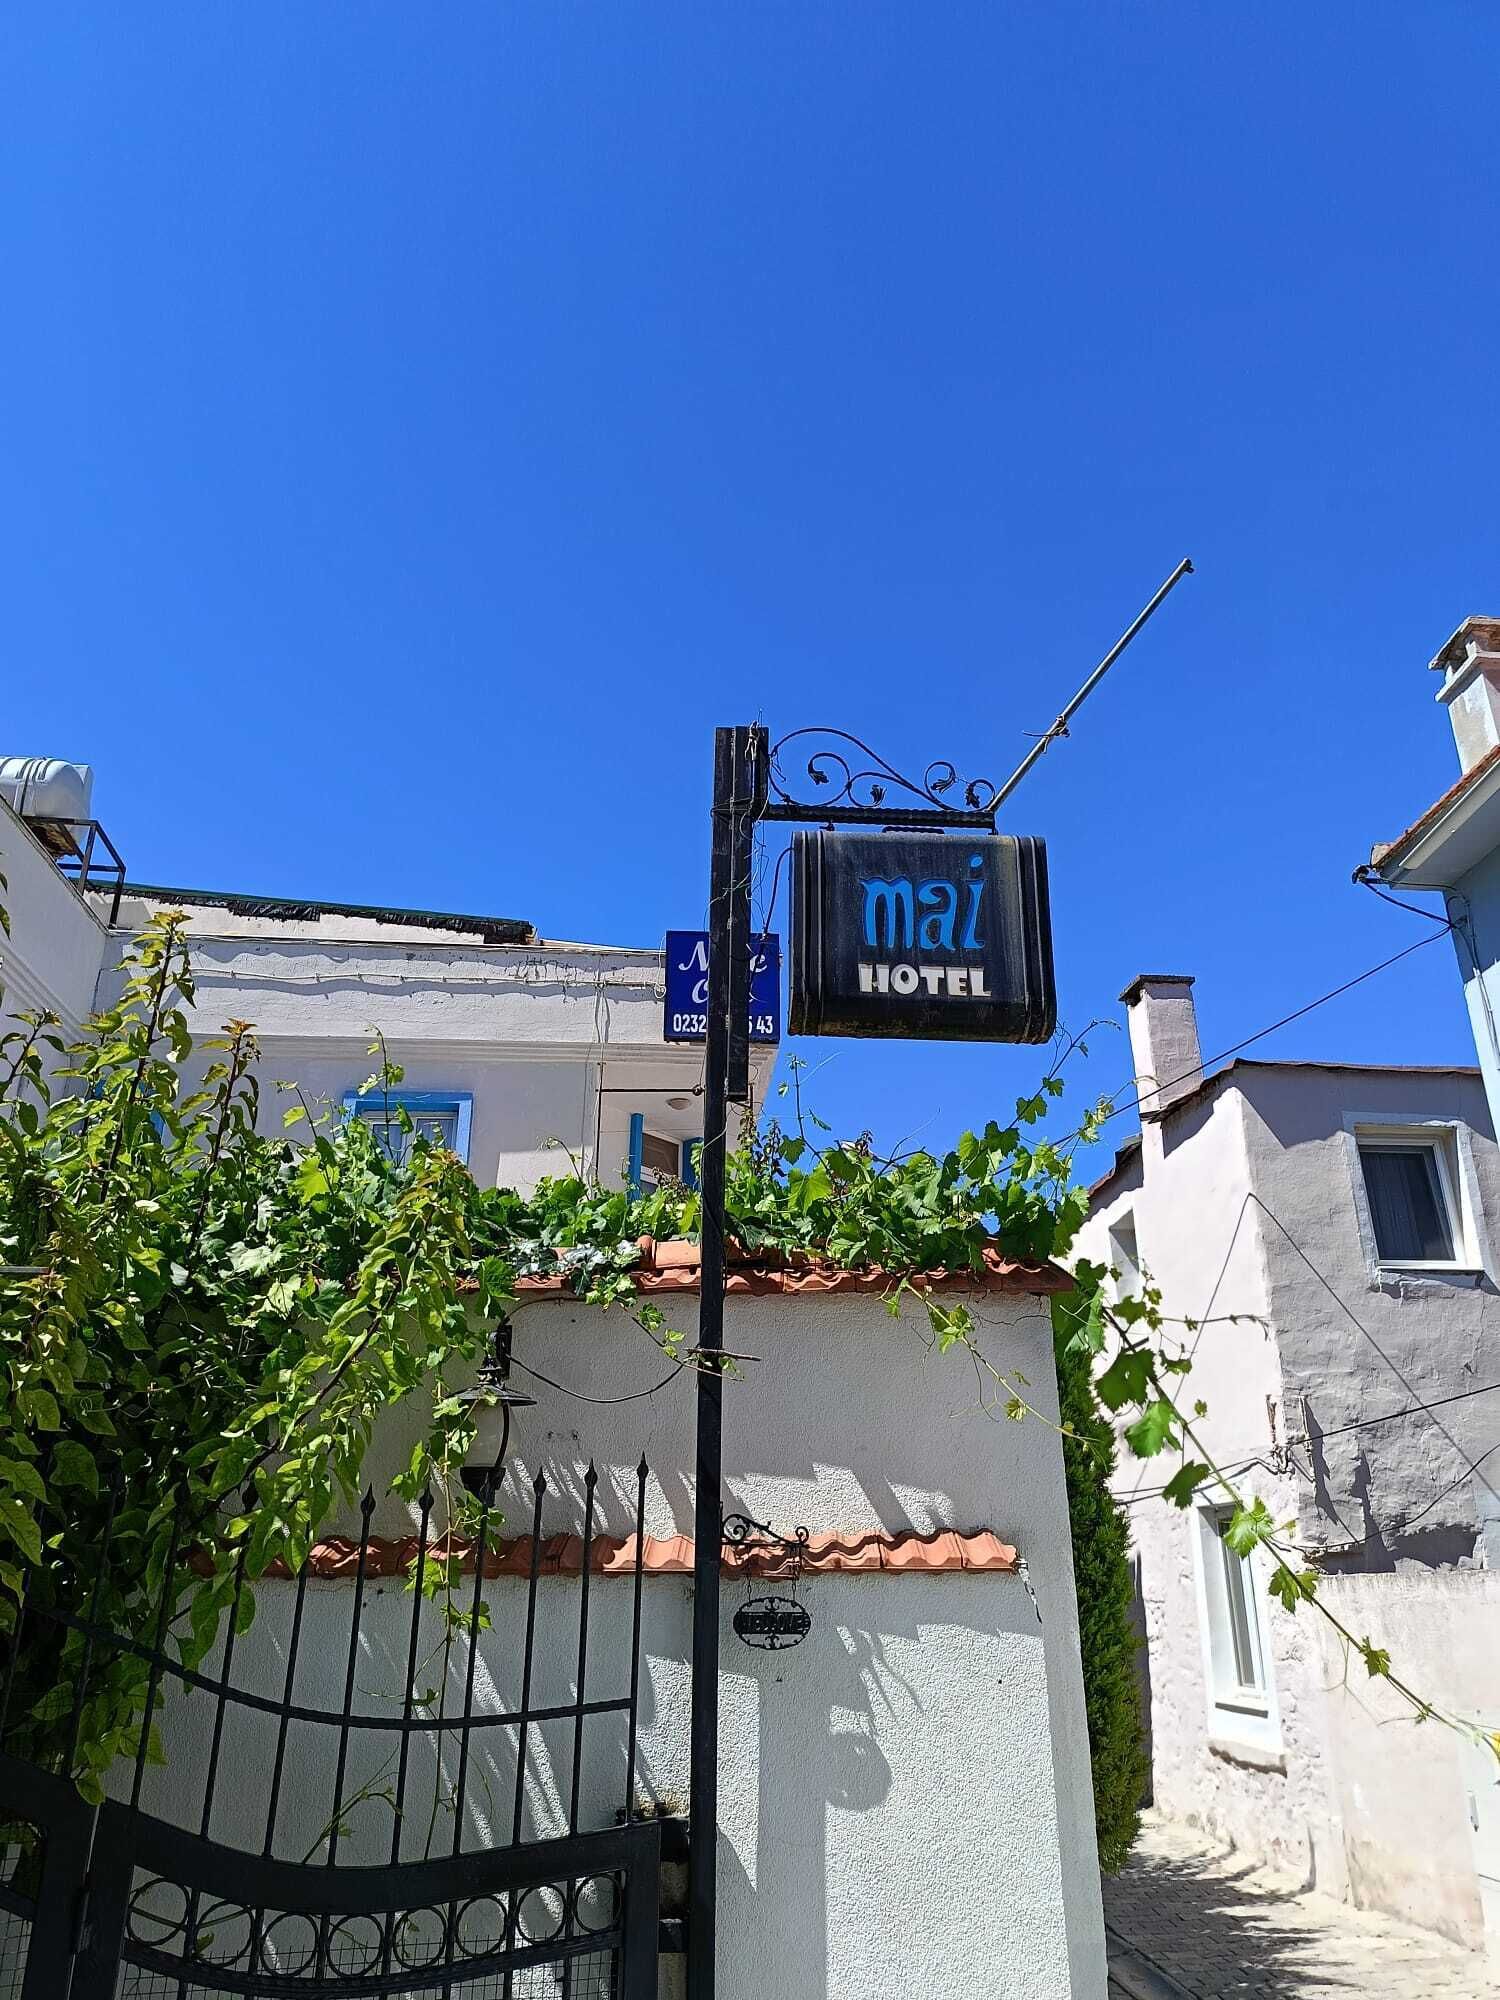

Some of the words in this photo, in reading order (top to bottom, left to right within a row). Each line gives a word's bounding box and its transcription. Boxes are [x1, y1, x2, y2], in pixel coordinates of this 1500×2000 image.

[858, 853, 986, 951] mai
[857, 963, 992, 997] HOTEL
[673, 1013, 707, 1033] 0232
[756, 1015, 774, 1034] 43
